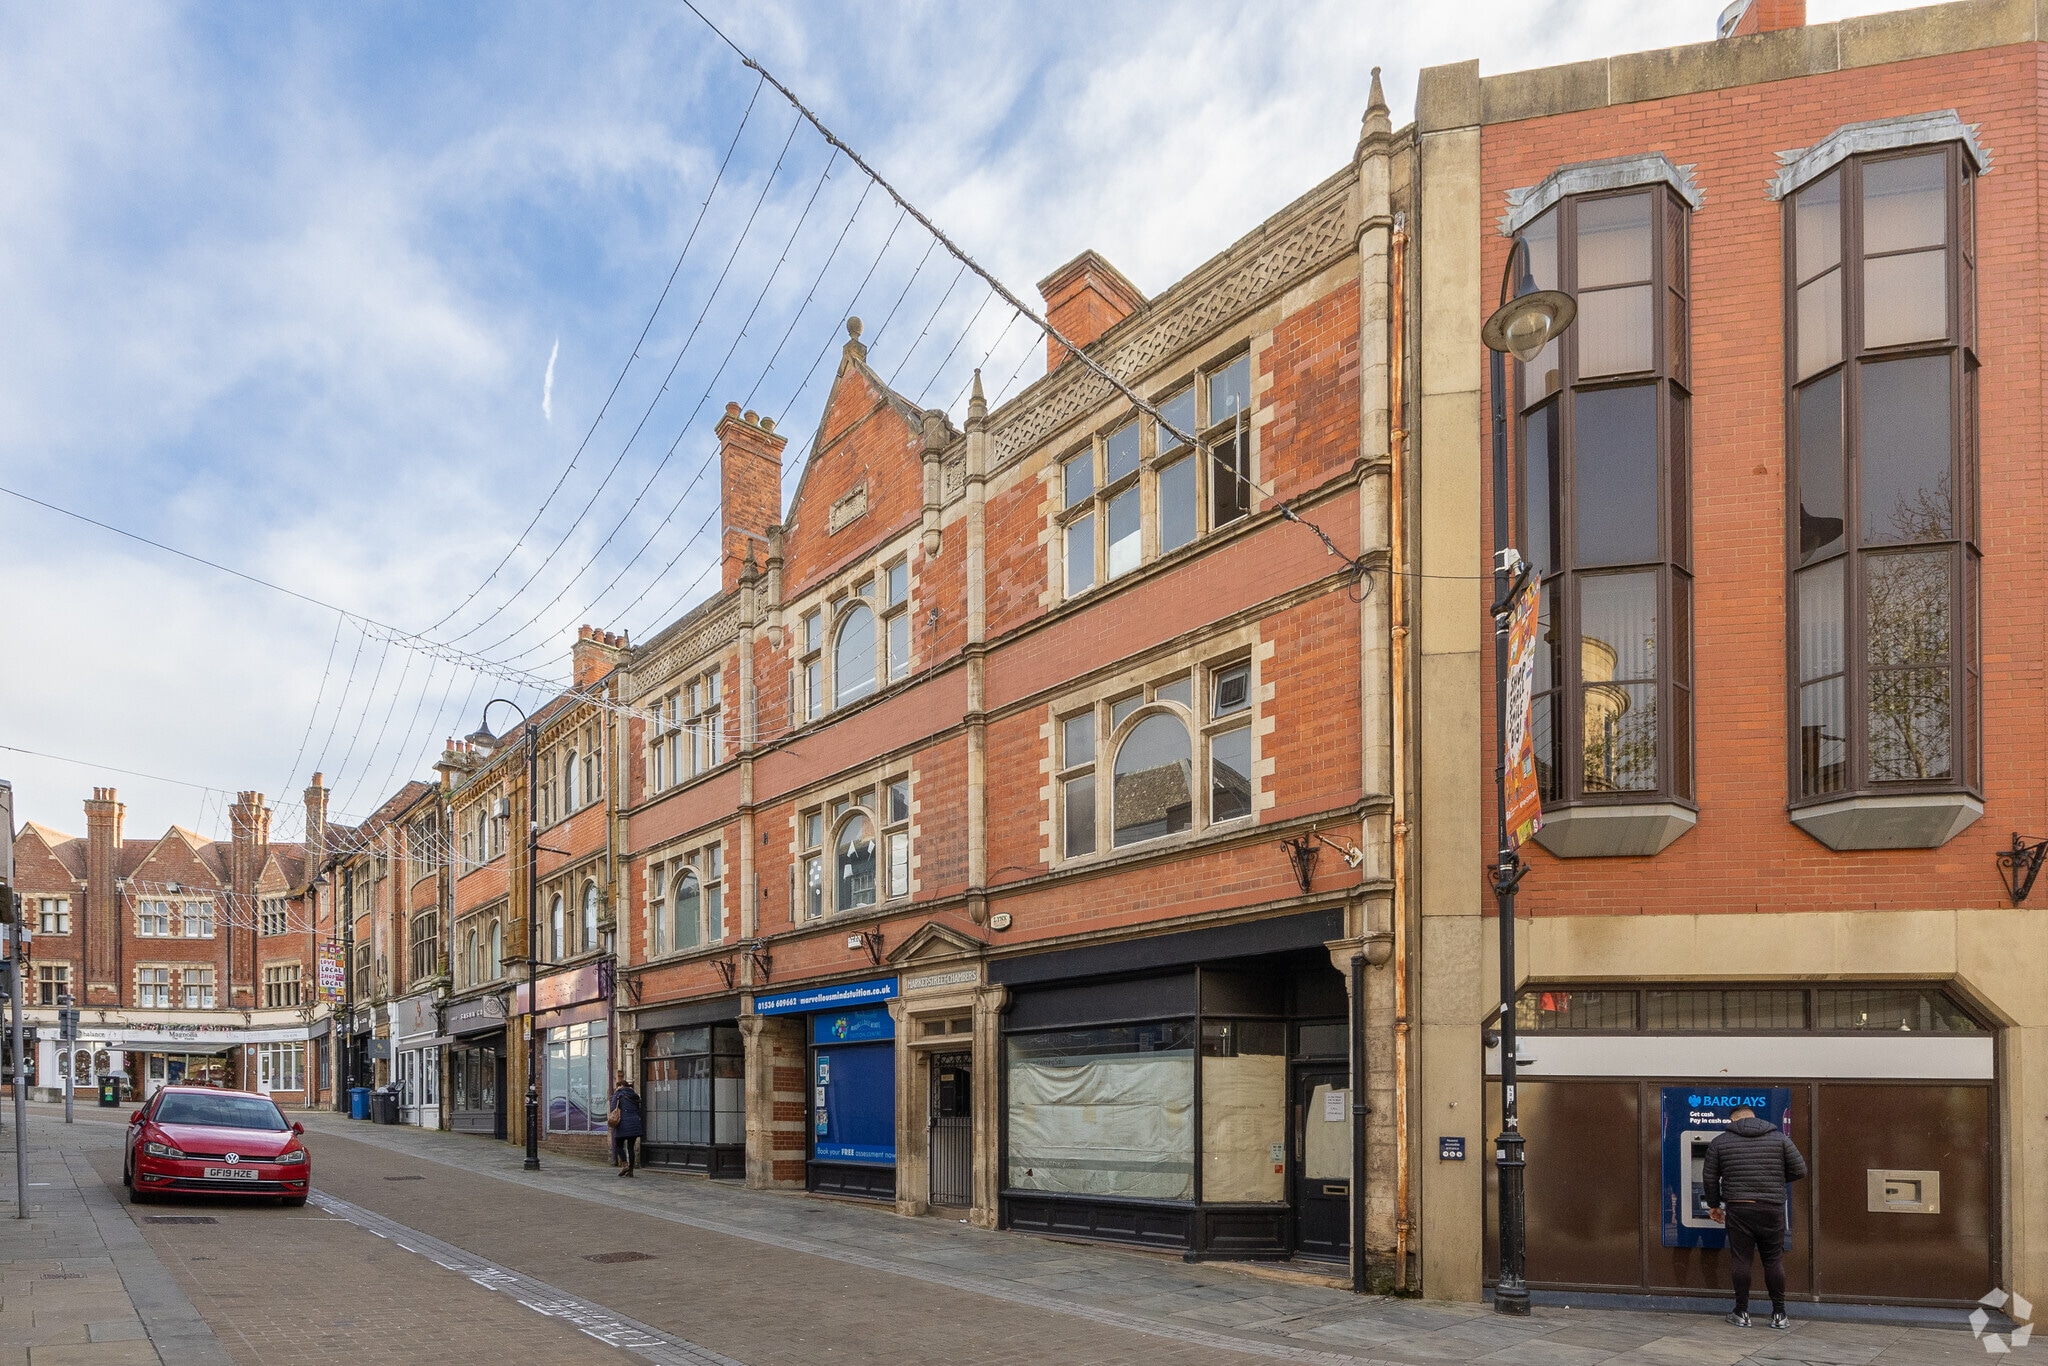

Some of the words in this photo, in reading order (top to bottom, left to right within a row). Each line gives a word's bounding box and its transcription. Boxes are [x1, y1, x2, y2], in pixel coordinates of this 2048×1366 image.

[1510, 661, 1526, 697] SHOP
[758, 1001, 775, 1010] 01536
[776, 998, 797, 1007] 609662
[800, 985, 890, 1004] marvellousmindstuition.co.uk
[1703, 1096, 1767, 1107] BARCLAYS
[818, 1147, 829, 1155] Book
[210, 1169, 231, 1177] GF19
[233, 1170, 252, 1178] HZE
